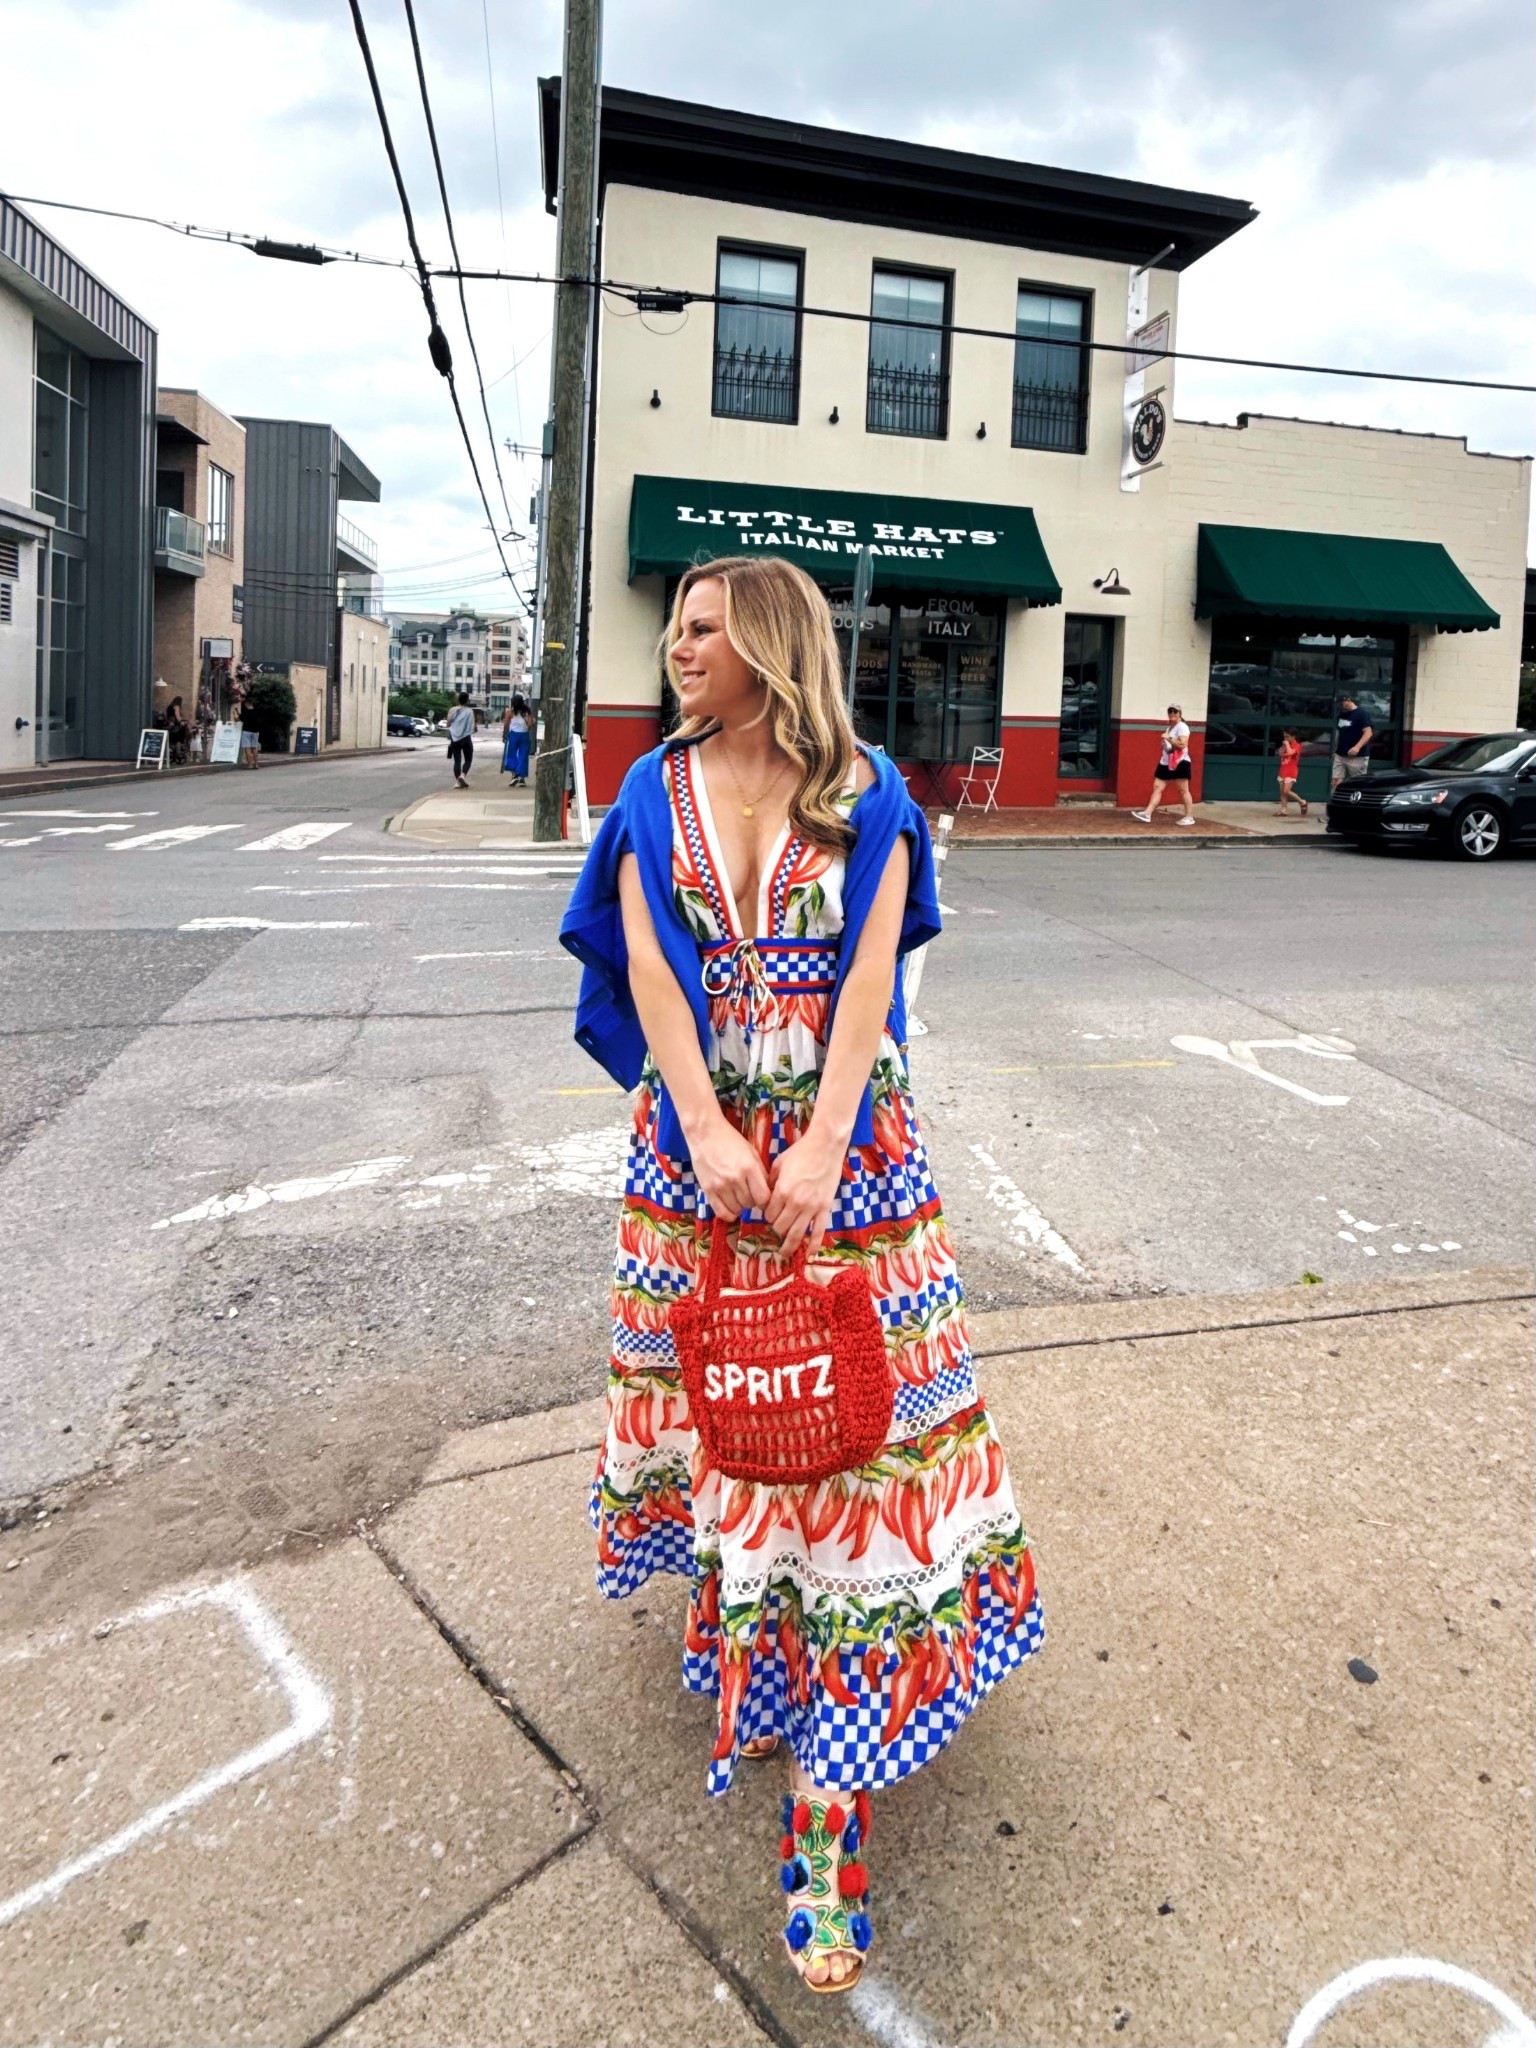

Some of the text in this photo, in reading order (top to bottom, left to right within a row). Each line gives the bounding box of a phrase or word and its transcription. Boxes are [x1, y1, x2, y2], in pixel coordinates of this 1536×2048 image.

[1134, 403, 1163, 433] WALDO'S
[676, 506, 997, 545] LITTLE HATS
[741, 532, 945, 559] ITALIAN MARKET
[927, 598, 974, 614] FROM
[927, 620, 971, 636] ITALY
[961, 656, 990, 667] WINE
[960, 673, 987, 682] BEER
[704, 1353, 836, 1406] SPRITZ
